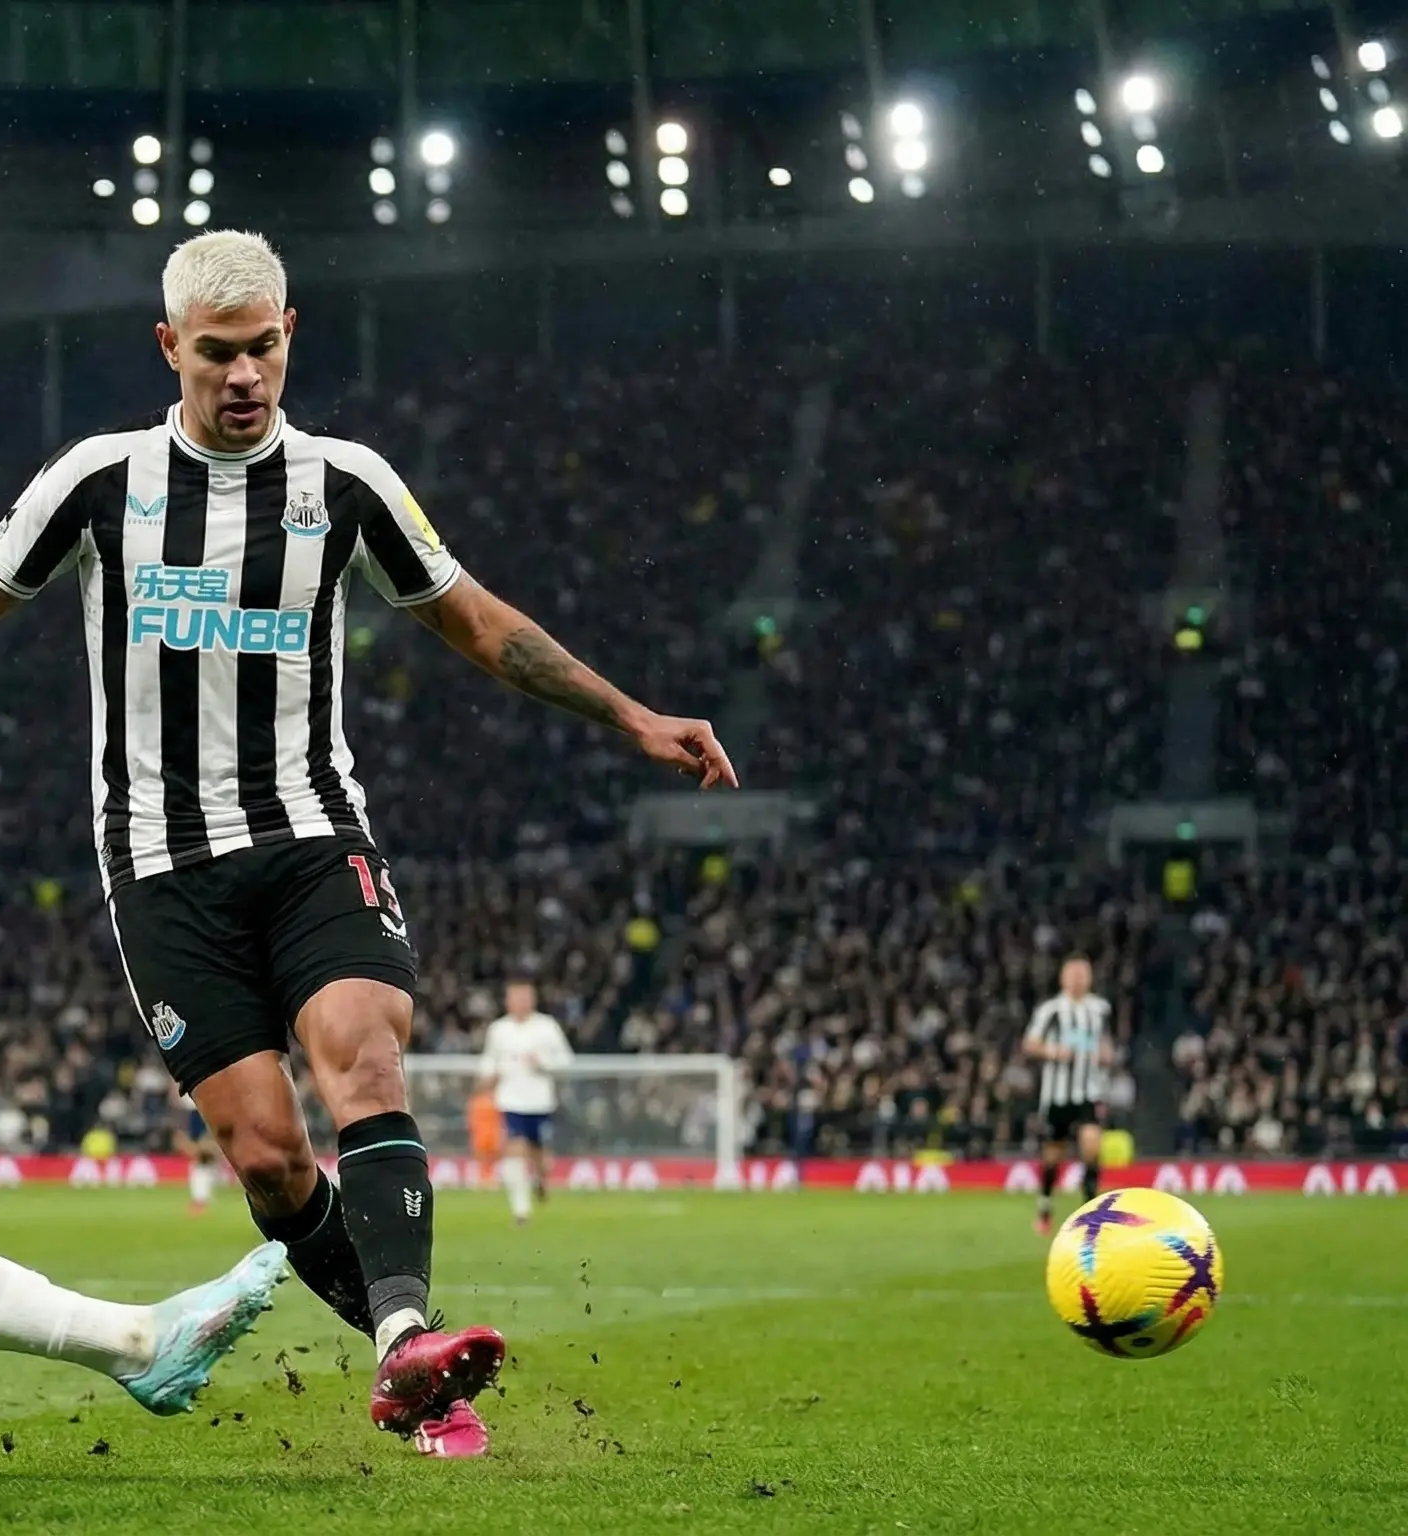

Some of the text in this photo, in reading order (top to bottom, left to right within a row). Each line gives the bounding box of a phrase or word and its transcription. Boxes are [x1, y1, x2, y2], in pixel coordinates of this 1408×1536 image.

[131, 563, 230, 603] 乐天堂
[130, 606, 310, 652] FUN88
[68, 1156, 159, 1188] AIA
[568, 1160, 659, 1191] AIA
[855, 1162, 950, 1194] AIA
[1152, 1163, 1248, 1197] AIA
[1303, 1164, 1399, 1197] AIA
